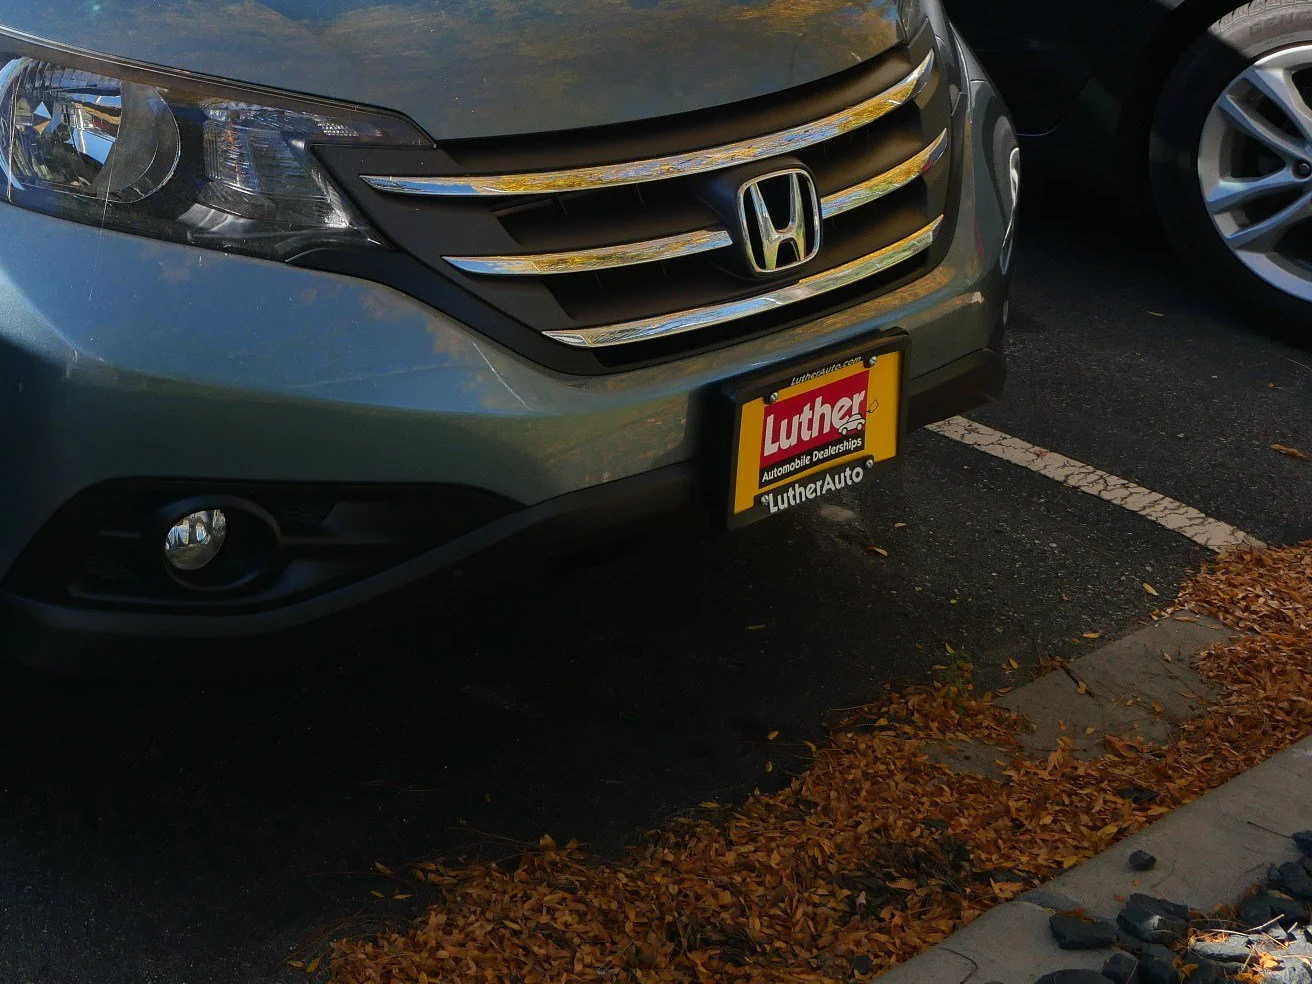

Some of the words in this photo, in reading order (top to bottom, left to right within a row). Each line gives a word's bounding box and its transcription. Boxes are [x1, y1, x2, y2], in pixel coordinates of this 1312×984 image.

[763, 390, 866, 457] Luther
[761, 454, 811, 483] Automobile
[812, 437, 862, 459] Dealerships
[768, 466, 864, 514] LutherAuto
